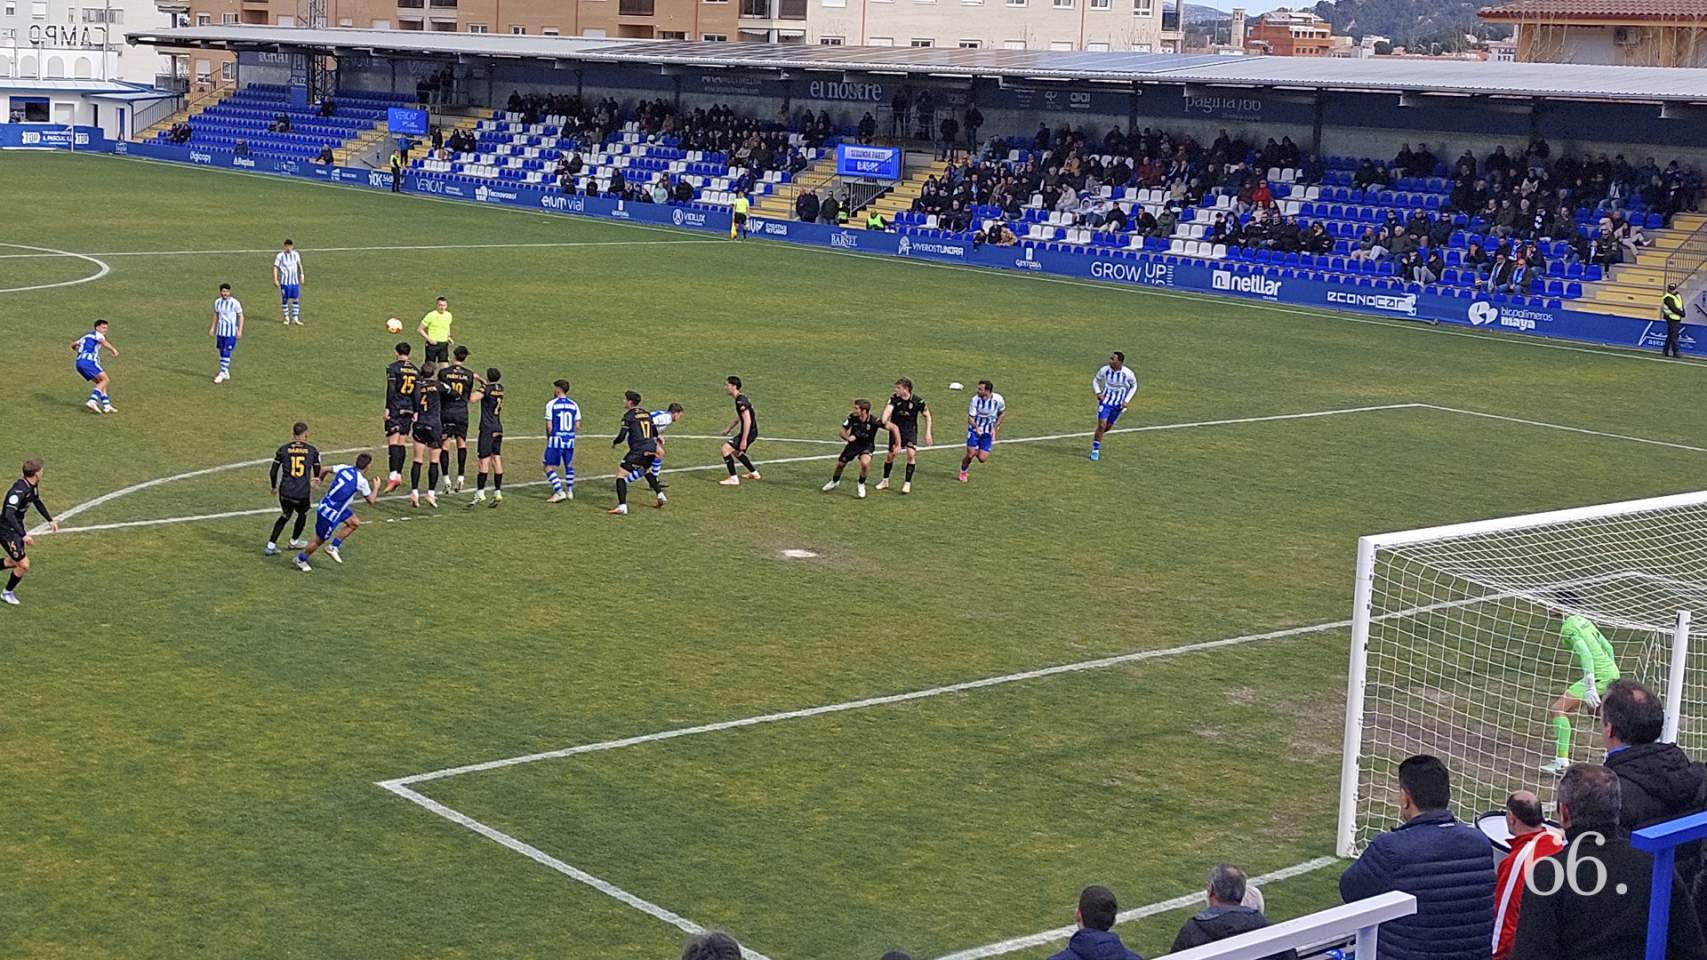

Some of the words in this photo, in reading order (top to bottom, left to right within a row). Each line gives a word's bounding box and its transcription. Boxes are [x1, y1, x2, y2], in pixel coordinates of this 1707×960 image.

[1091, 261, 1142, 282] GROW
[1145, 262, 1167, 279] UP
[1230, 274, 1282, 297] netllar
[1501, 316, 1536, 331] maya
[401, 375, 416, 394] 25
[558, 411, 573, 431] 10
[640, 421, 650, 439] 17
[291, 456, 305, 477] 15
[329, 478, 346, 496] 7
